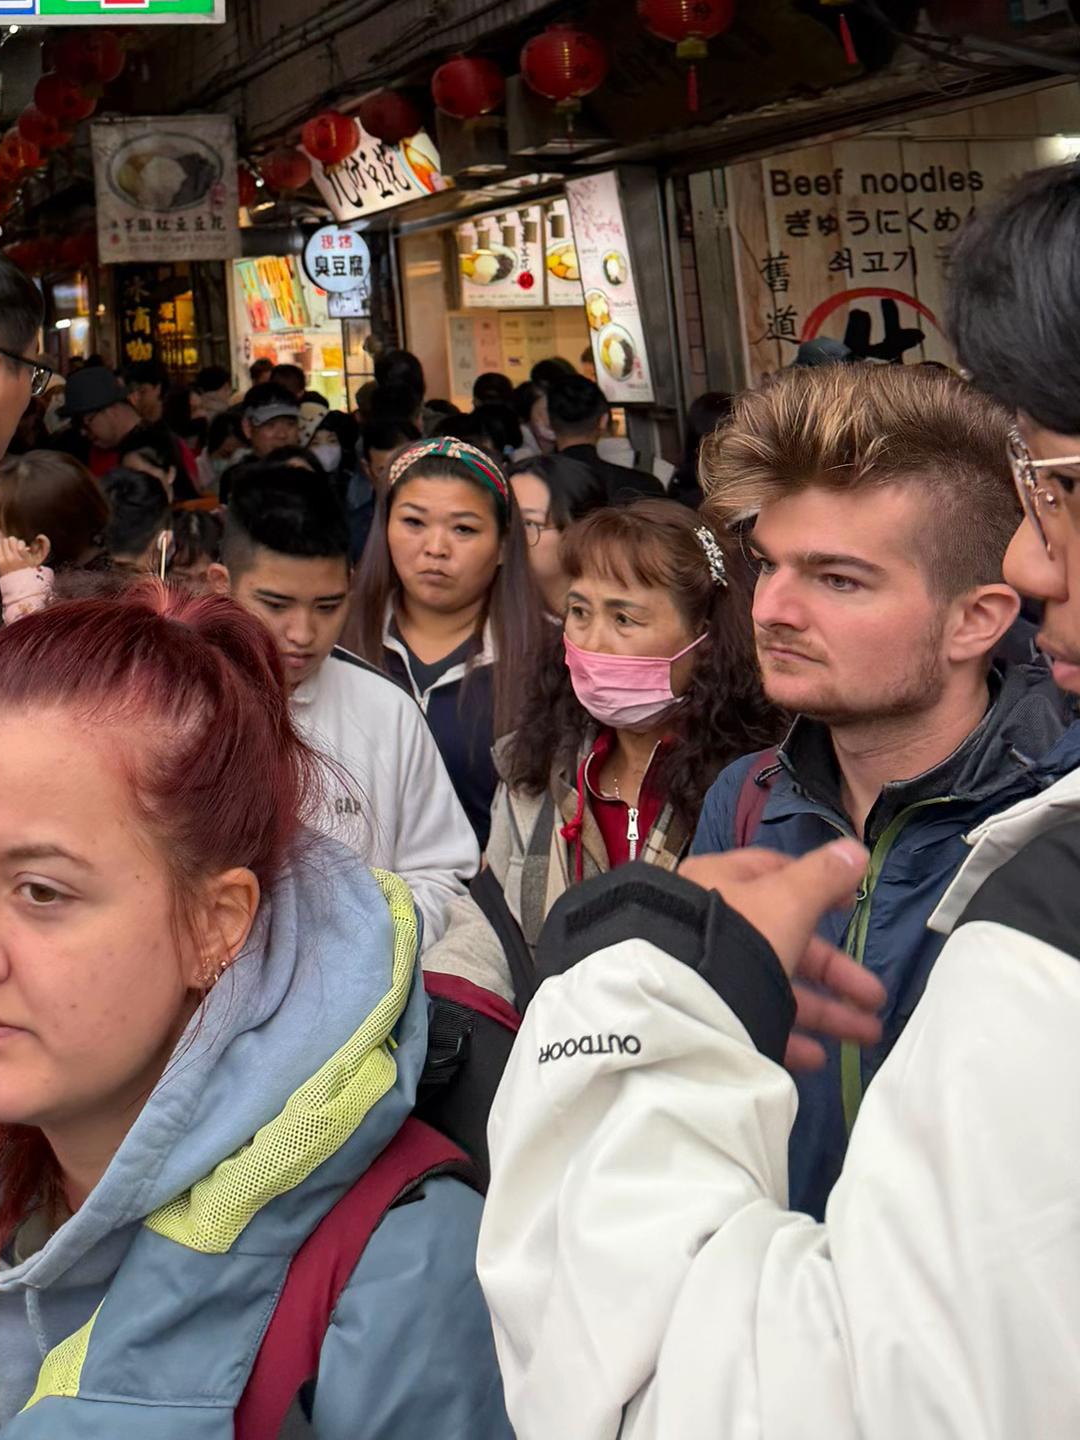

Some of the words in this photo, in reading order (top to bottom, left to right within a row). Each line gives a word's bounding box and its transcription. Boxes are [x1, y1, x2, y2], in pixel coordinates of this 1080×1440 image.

[770, 168, 843, 196] Beef
[860, 165, 985, 195] noodles
[785, 206, 975, 237] ぎゅうにくめ
[314, 255, 364, 278] 臭豆腐
[828, 246, 917, 278] 쇠고기
[759, 250, 803, 345] 舊道
[335, 797, 362, 815] GAP
[538, 1033, 642, 1065] OUTDOOR
